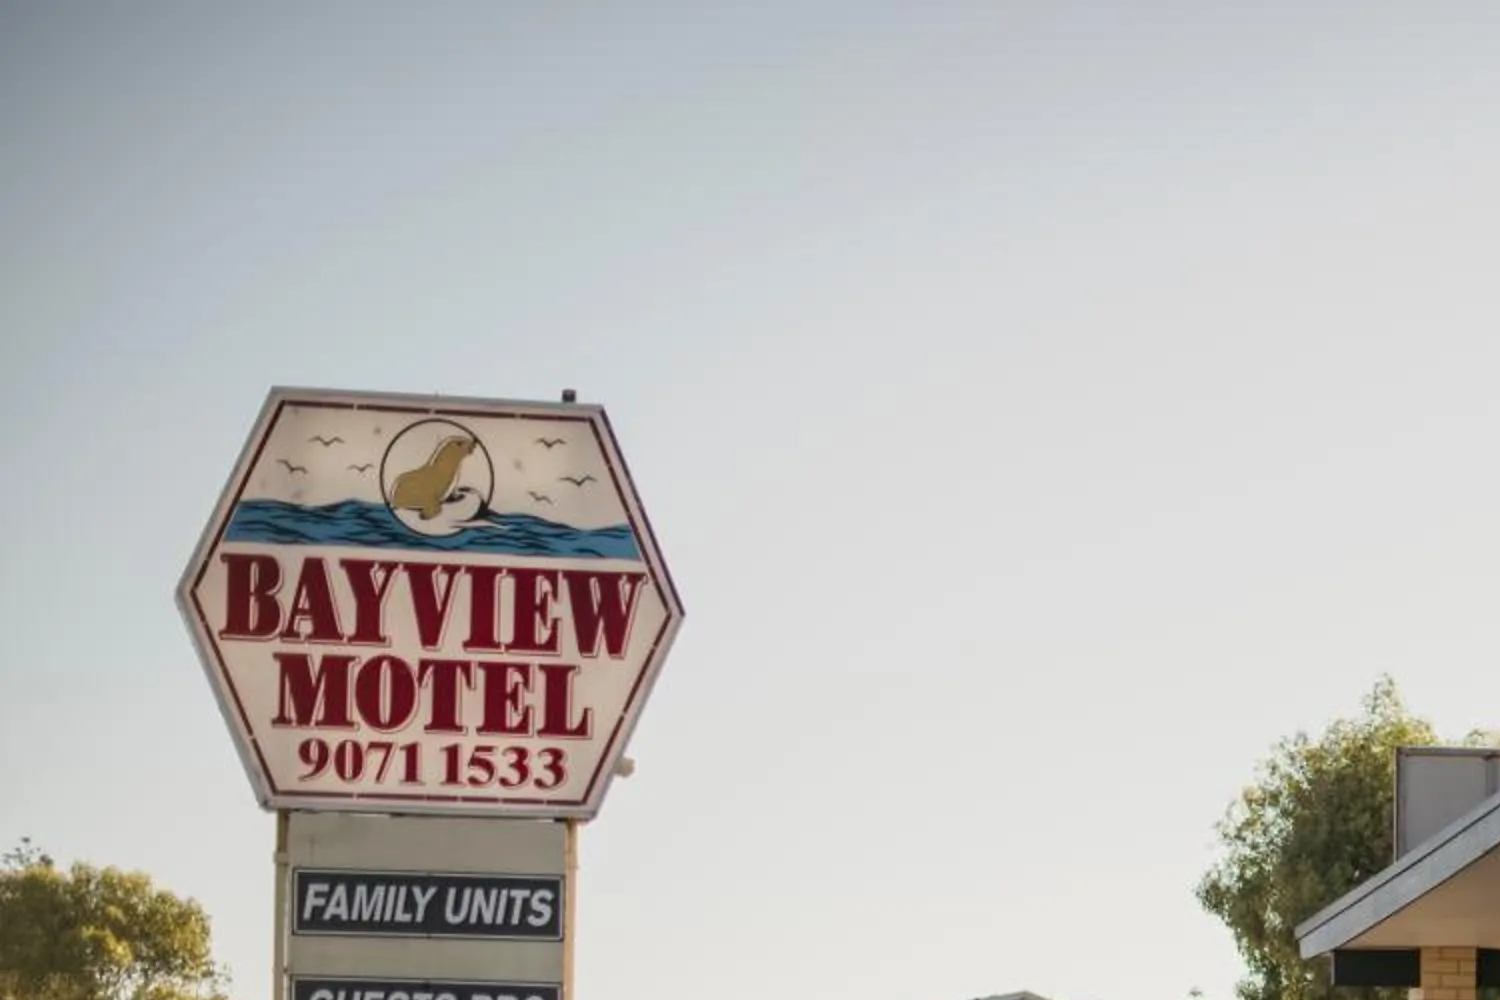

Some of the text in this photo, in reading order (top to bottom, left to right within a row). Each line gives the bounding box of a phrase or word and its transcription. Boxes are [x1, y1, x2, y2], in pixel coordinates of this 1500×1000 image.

[219, 553, 647, 658] BAYVIEW
[271, 652, 593, 740] MOTEL
[297, 738, 567, 790] 9071 1533
[303, 882, 555, 927] FAMILY UNITS
